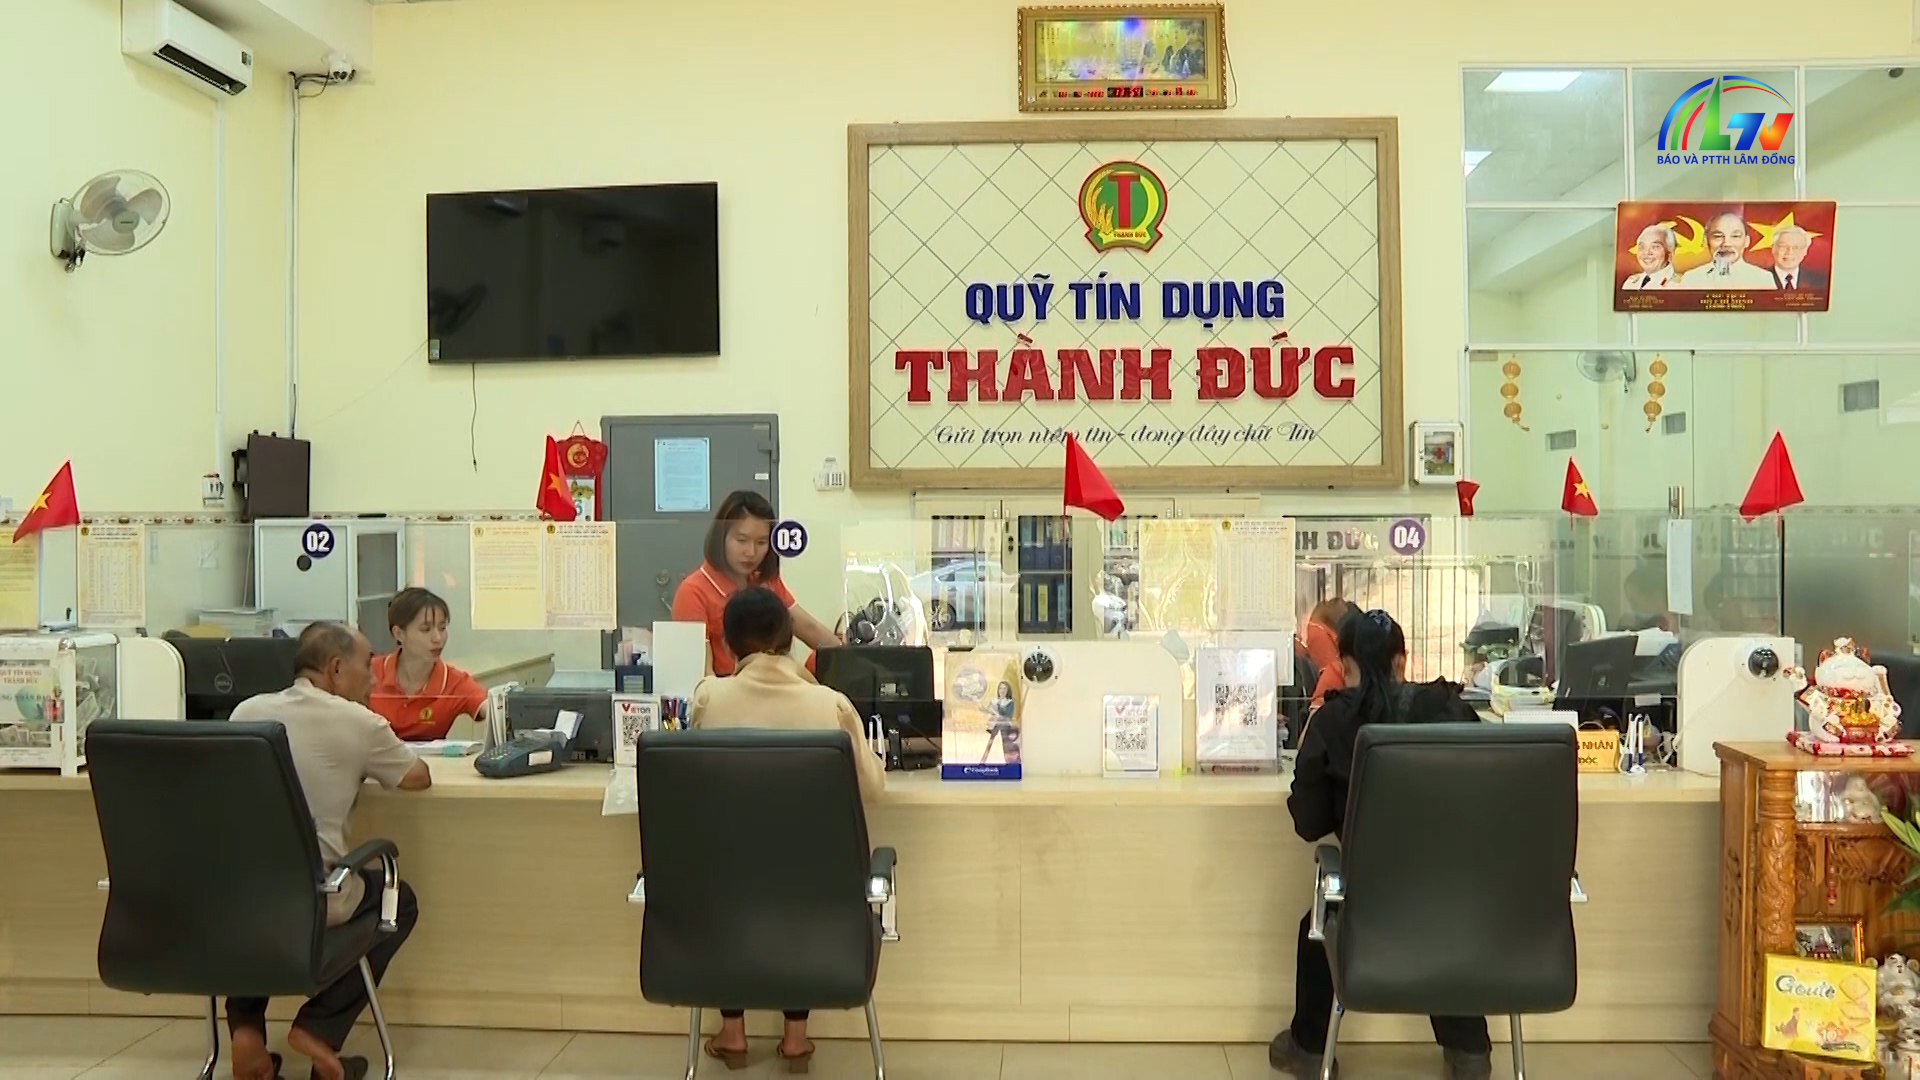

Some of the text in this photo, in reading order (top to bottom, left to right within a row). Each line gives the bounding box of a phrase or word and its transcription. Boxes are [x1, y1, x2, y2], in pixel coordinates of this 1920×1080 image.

[965, 270, 1285, 328] QUỸ TÍN DỤNG
[894, 331, 1355, 402] THÀNH ĐỨC
[981, 427, 1023, 446] trọn
[306, 531, 330, 552] 02
[777, 528, 802, 551] 03
[1393, 525, 1420, 549] 04
[1582, 740, 1614, 750] NHÂN
